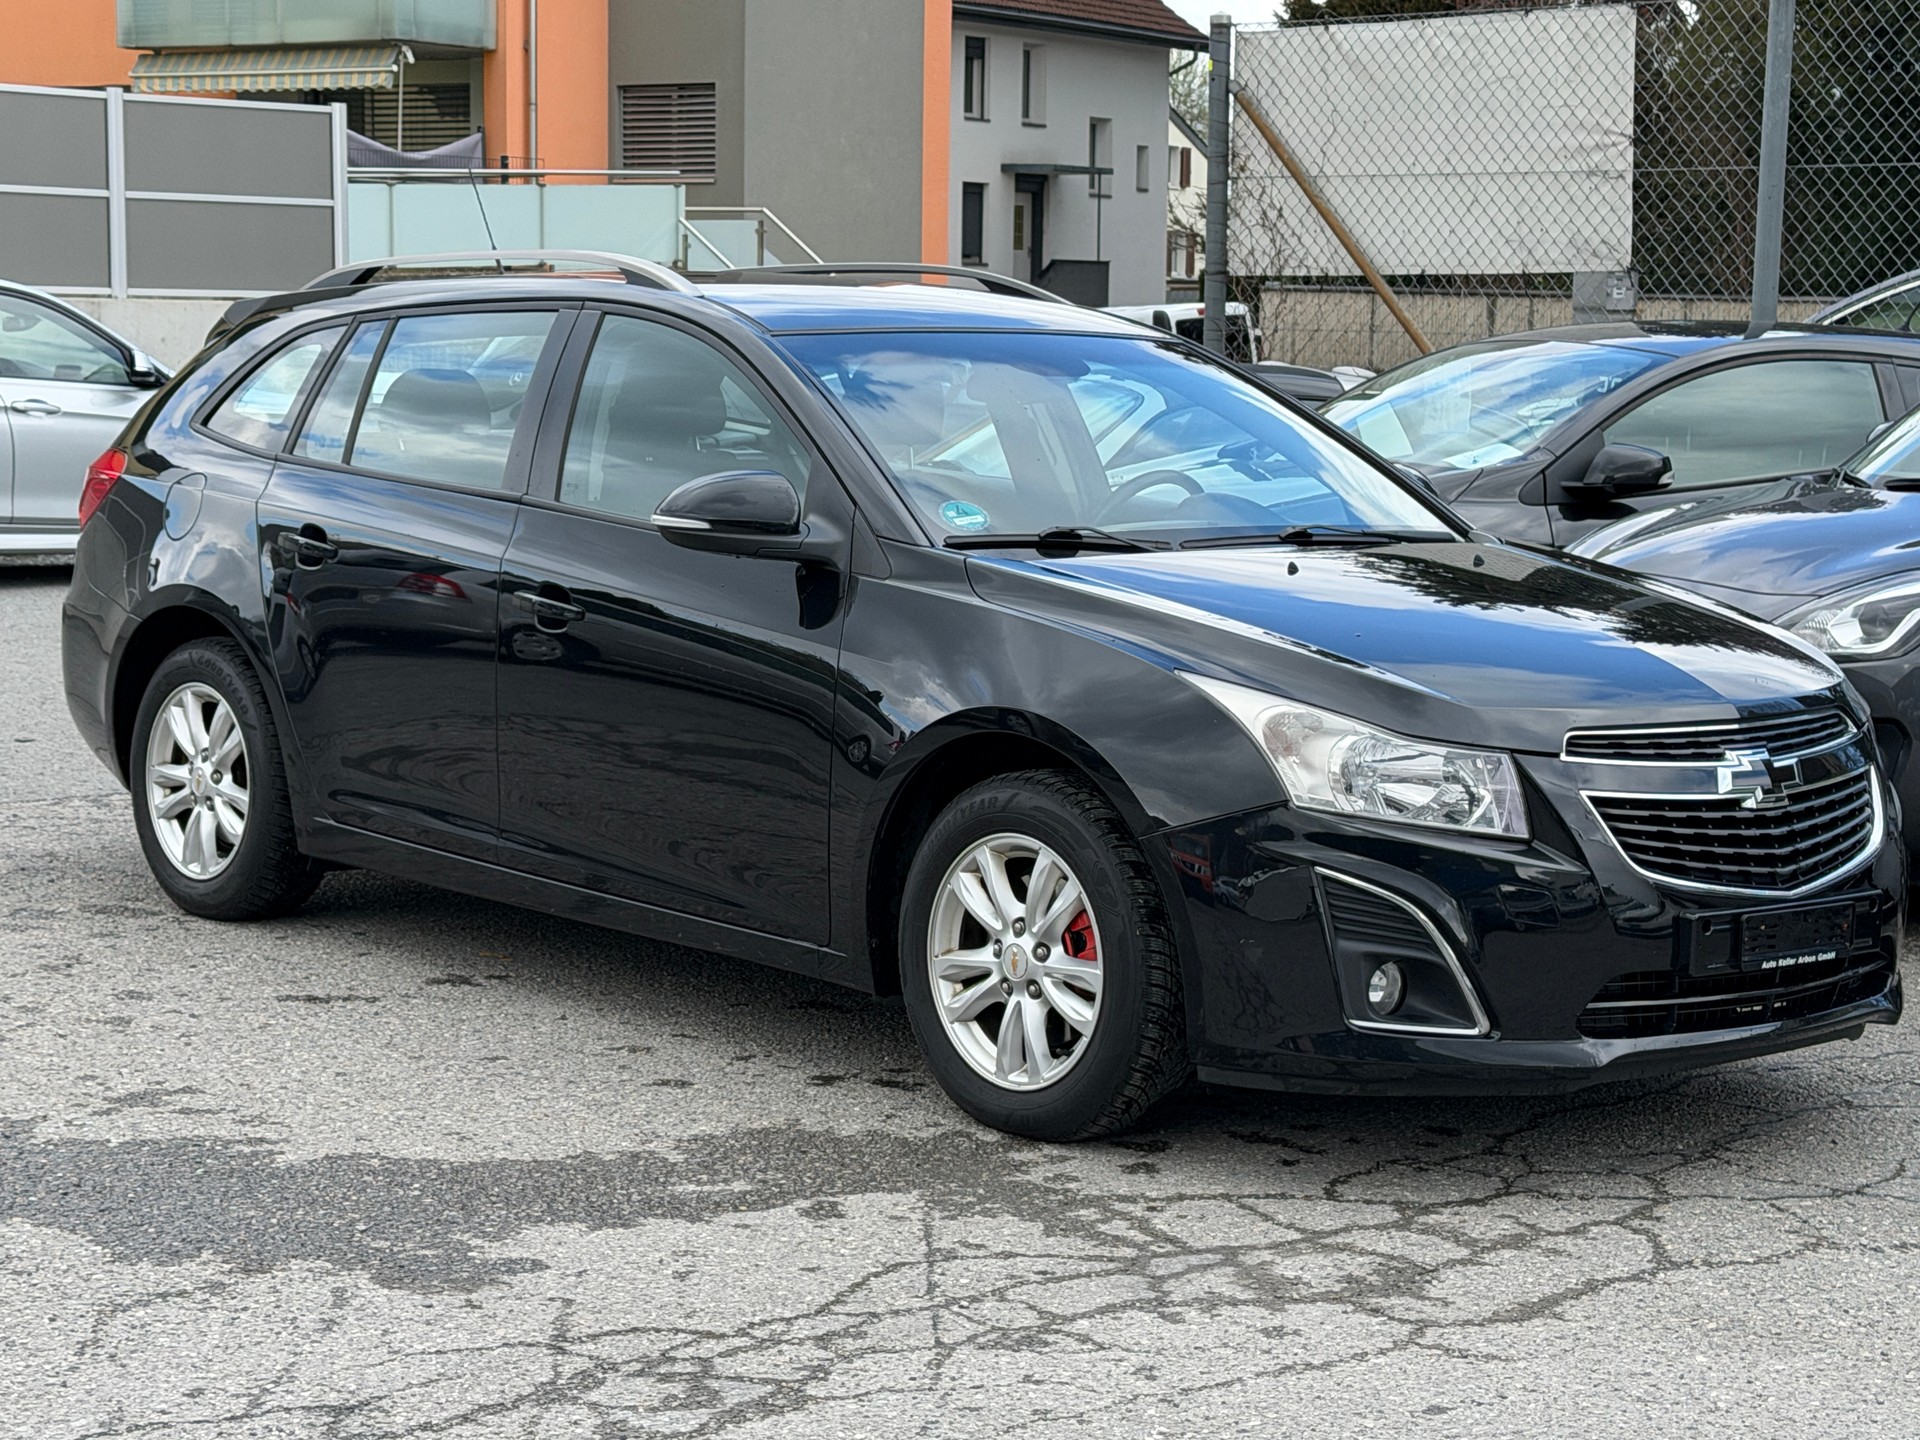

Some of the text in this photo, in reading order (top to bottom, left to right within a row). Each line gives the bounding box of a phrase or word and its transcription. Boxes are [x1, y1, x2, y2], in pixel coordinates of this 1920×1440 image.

[1761, 950, 1836, 970] Auto Keller Arbon GmbH
